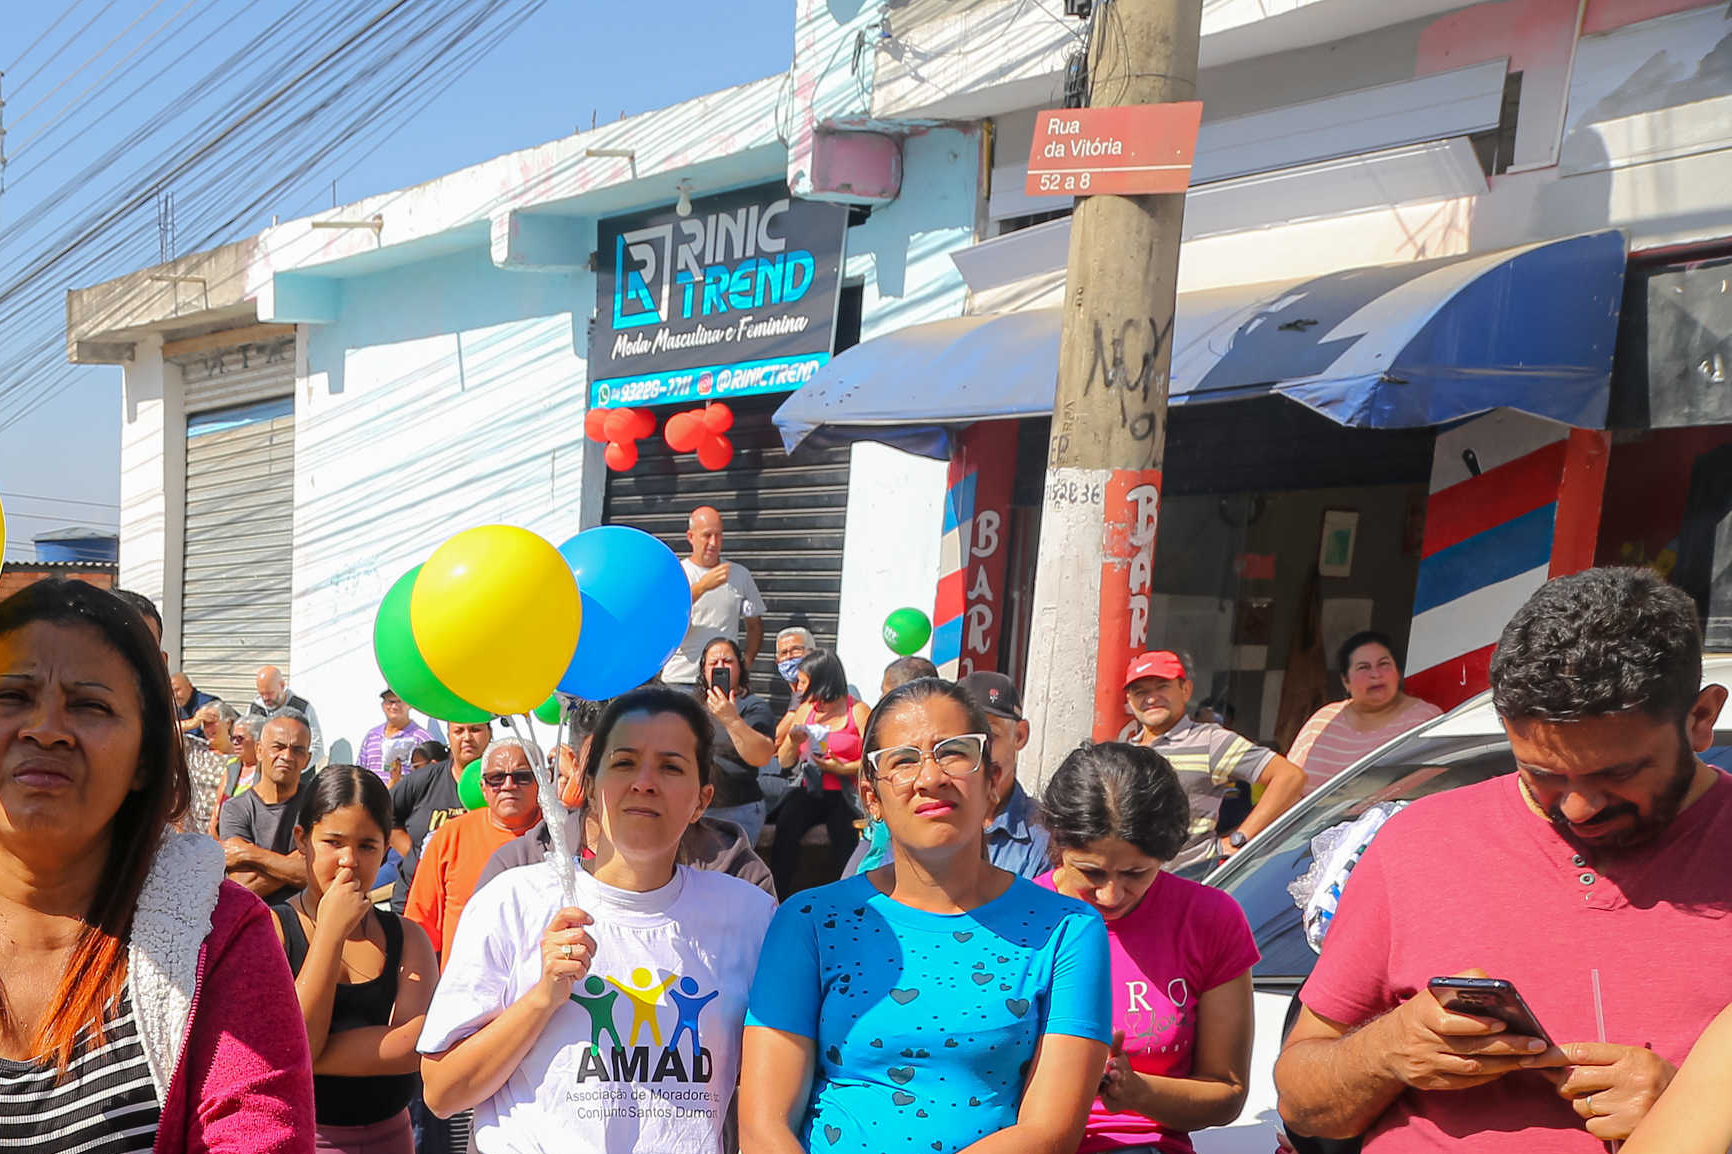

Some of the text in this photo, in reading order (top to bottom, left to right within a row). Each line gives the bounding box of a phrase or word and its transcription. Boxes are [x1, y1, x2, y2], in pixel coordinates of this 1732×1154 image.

[1048, 118, 1080, 135] Rua
[1044, 138, 1122, 158] da Vitória
[1039, 173, 1091, 190] 52 a 8
[676, 199, 789, 282] RINIC
[675, 250, 815, 319] TREND
[611, 333, 652, 361] Moda
[652, 324, 725, 355] Masculina
[736, 315, 809, 342] Feminina
[576, 1046, 713, 1083] AMAD
[566, 1088, 627, 1104] Associação
[630, 1089, 647, 1101] de
[577, 1106, 627, 1121] Conjunto
[628, 1106, 672, 1120] Santos
